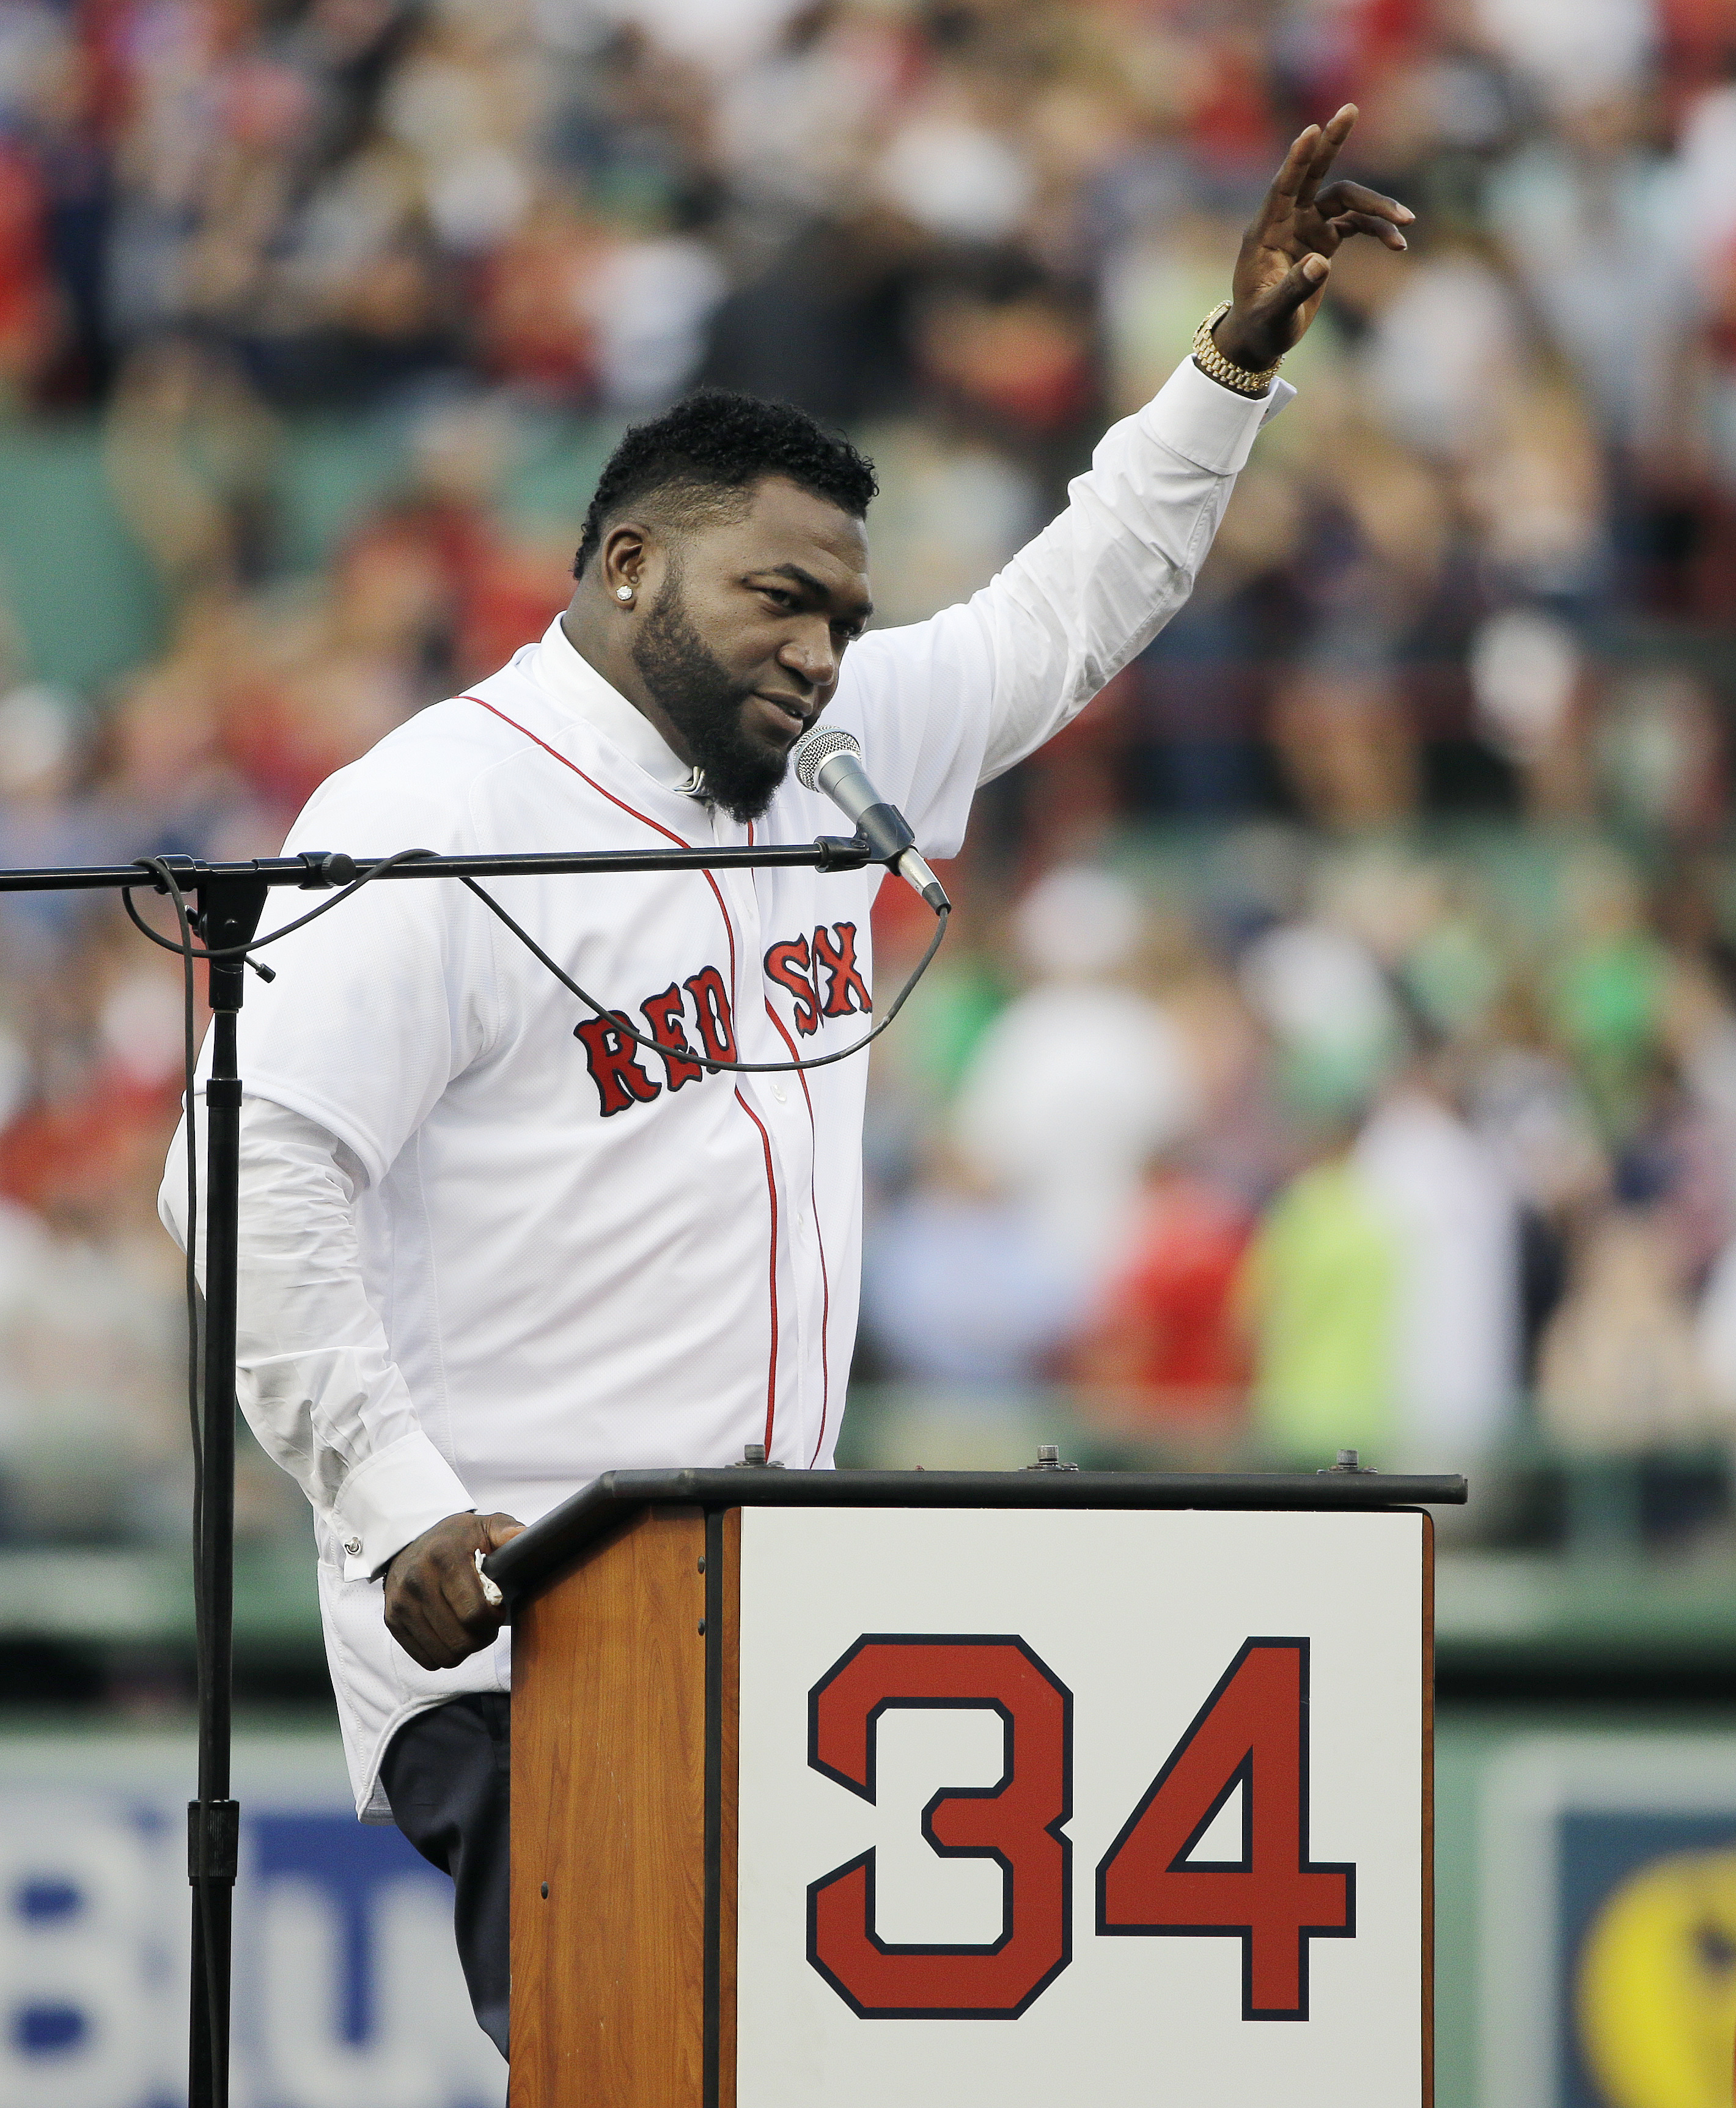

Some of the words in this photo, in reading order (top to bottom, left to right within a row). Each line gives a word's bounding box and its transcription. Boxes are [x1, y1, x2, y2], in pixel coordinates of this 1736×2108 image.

[573, 965, 737, 1117] RED
[763, 921, 873, 1039] SX
[806, 1633, 1356, 2021] 34
